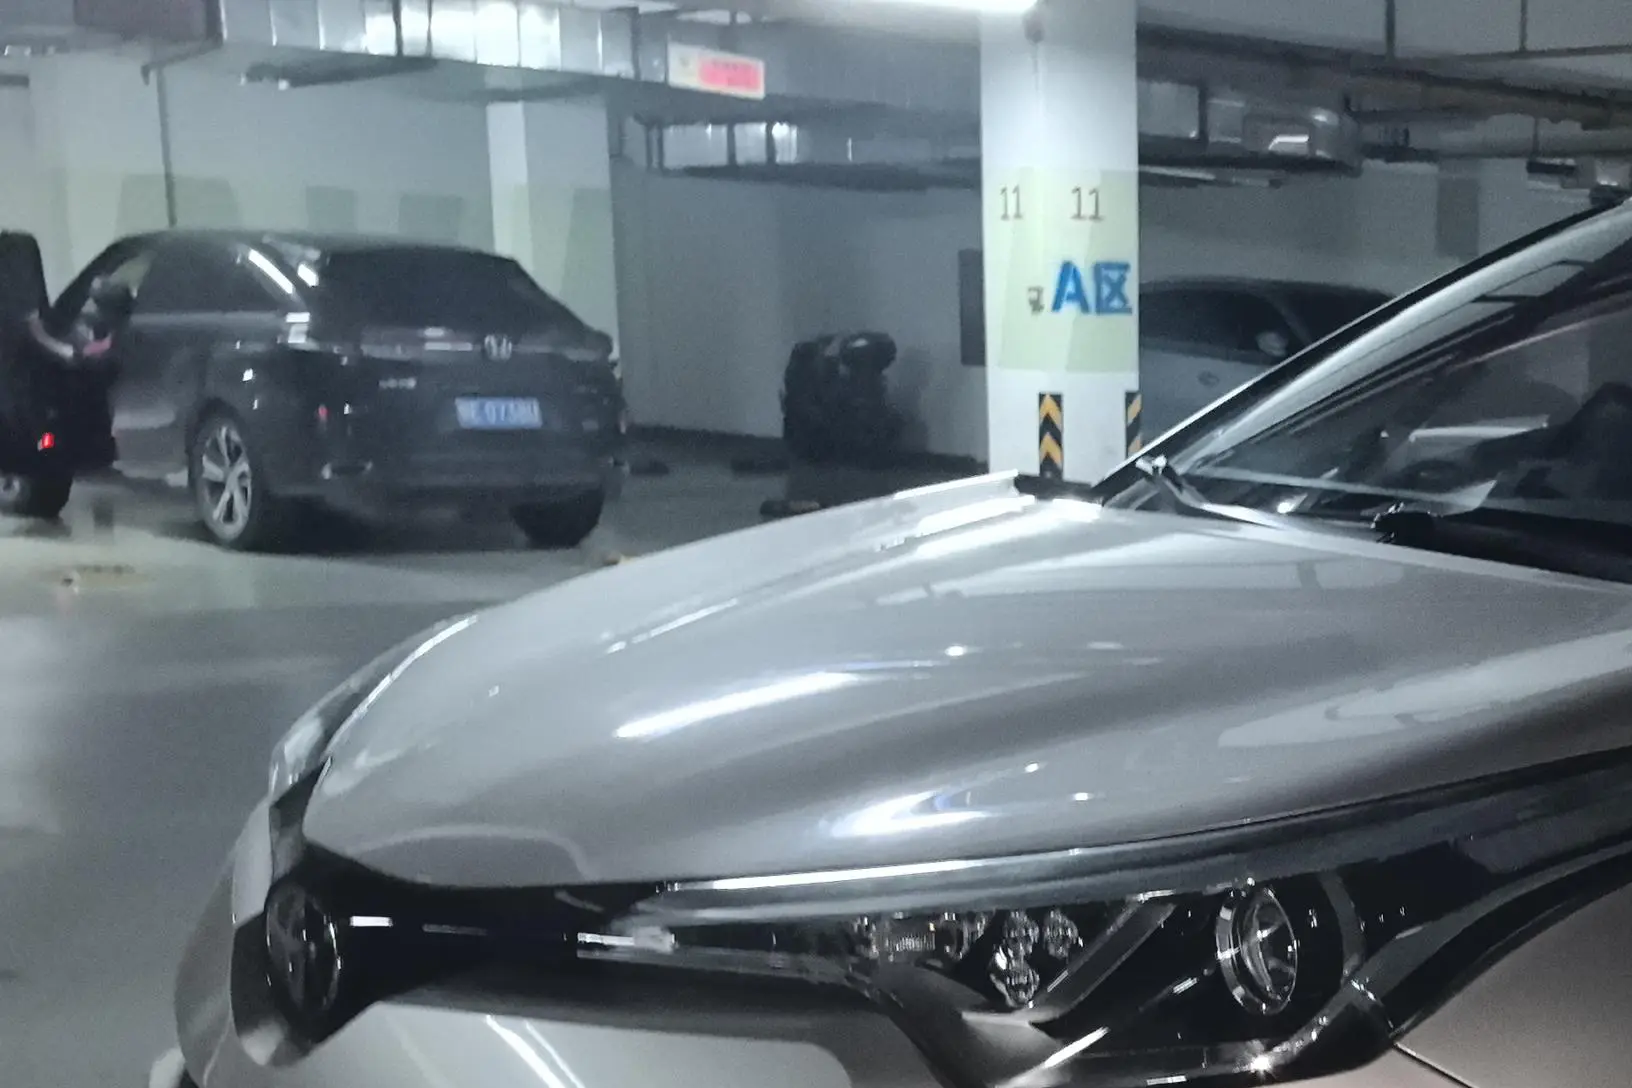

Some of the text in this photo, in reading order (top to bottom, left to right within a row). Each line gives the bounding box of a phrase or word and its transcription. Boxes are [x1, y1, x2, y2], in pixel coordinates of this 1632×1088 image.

[1000, 185, 1023, 220] 11
[1071, 186, 1104, 221] 11
[1051, 260, 1133, 315] A区
